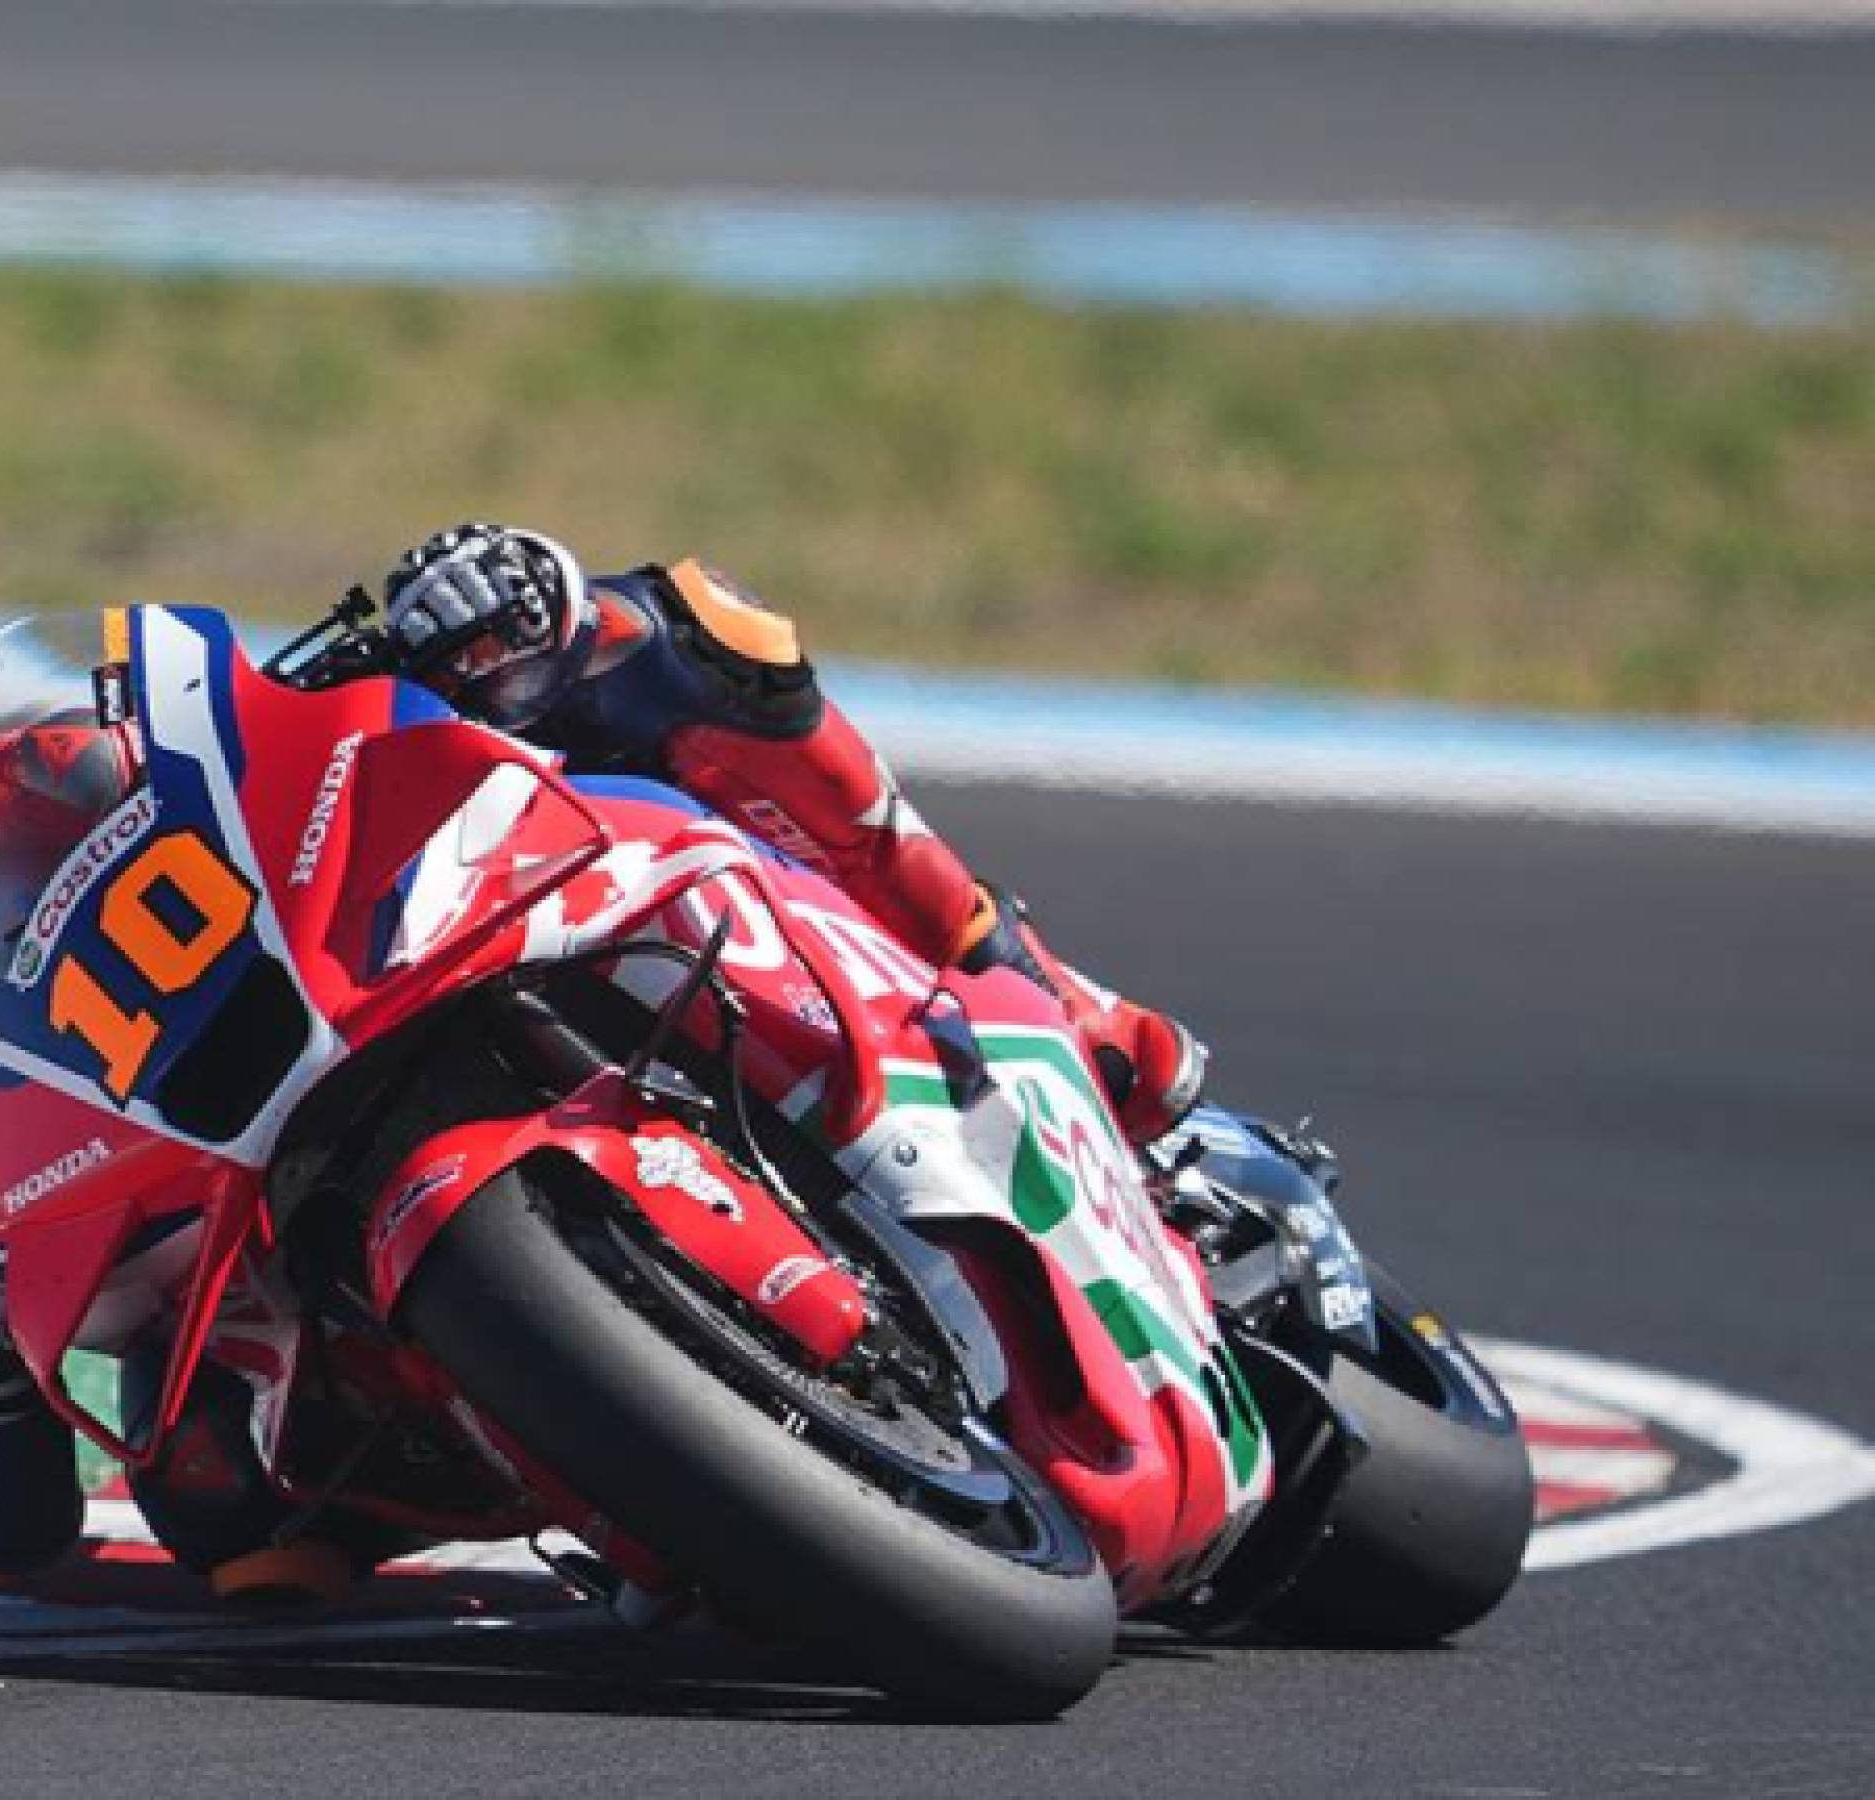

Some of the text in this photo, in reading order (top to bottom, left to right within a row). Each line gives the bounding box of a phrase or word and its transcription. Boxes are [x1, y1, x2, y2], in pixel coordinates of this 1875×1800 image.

[35, 797, 155, 941] Castrol
[290, 729, 365, 887] HONDA
[49, 831, 258, 1104] 10
[4, 1138, 114, 1214] HONDA
